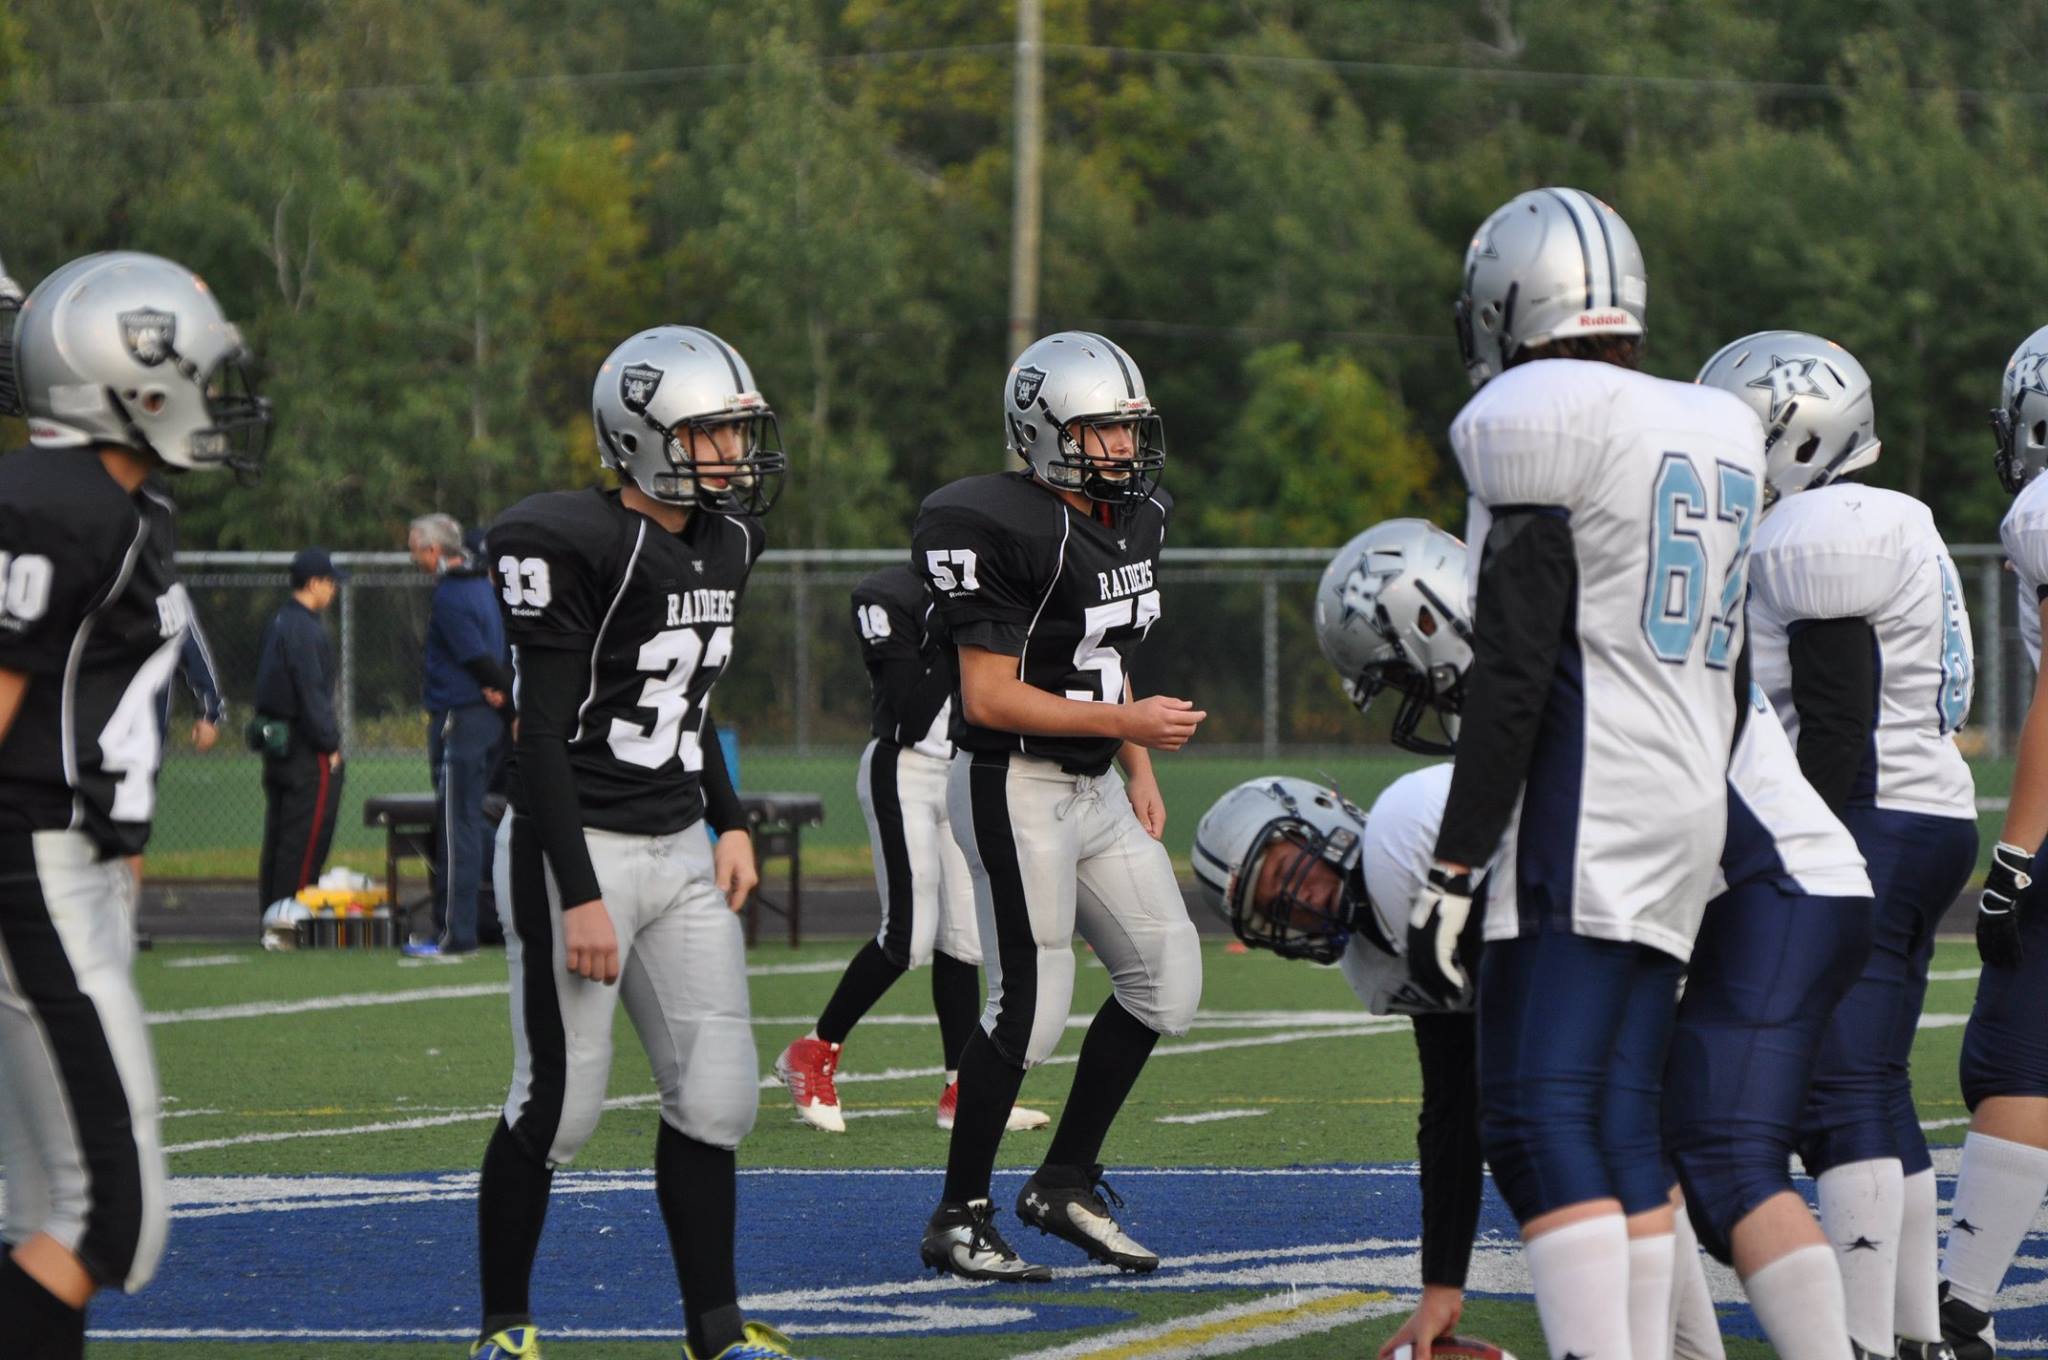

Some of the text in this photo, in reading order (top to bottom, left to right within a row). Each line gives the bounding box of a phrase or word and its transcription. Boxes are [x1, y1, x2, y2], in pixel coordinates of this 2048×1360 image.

[1578, 312, 1628, 327] Riddell
[498, 555, 552, 608] 33
[926, 549, 980, 591] 57
[1097, 559, 1153, 600] RAIDERS
[1641, 451, 1757, 670] 67
[0, 551, 54, 621] 0
[666, 588, 736, 627] RAIDERS
